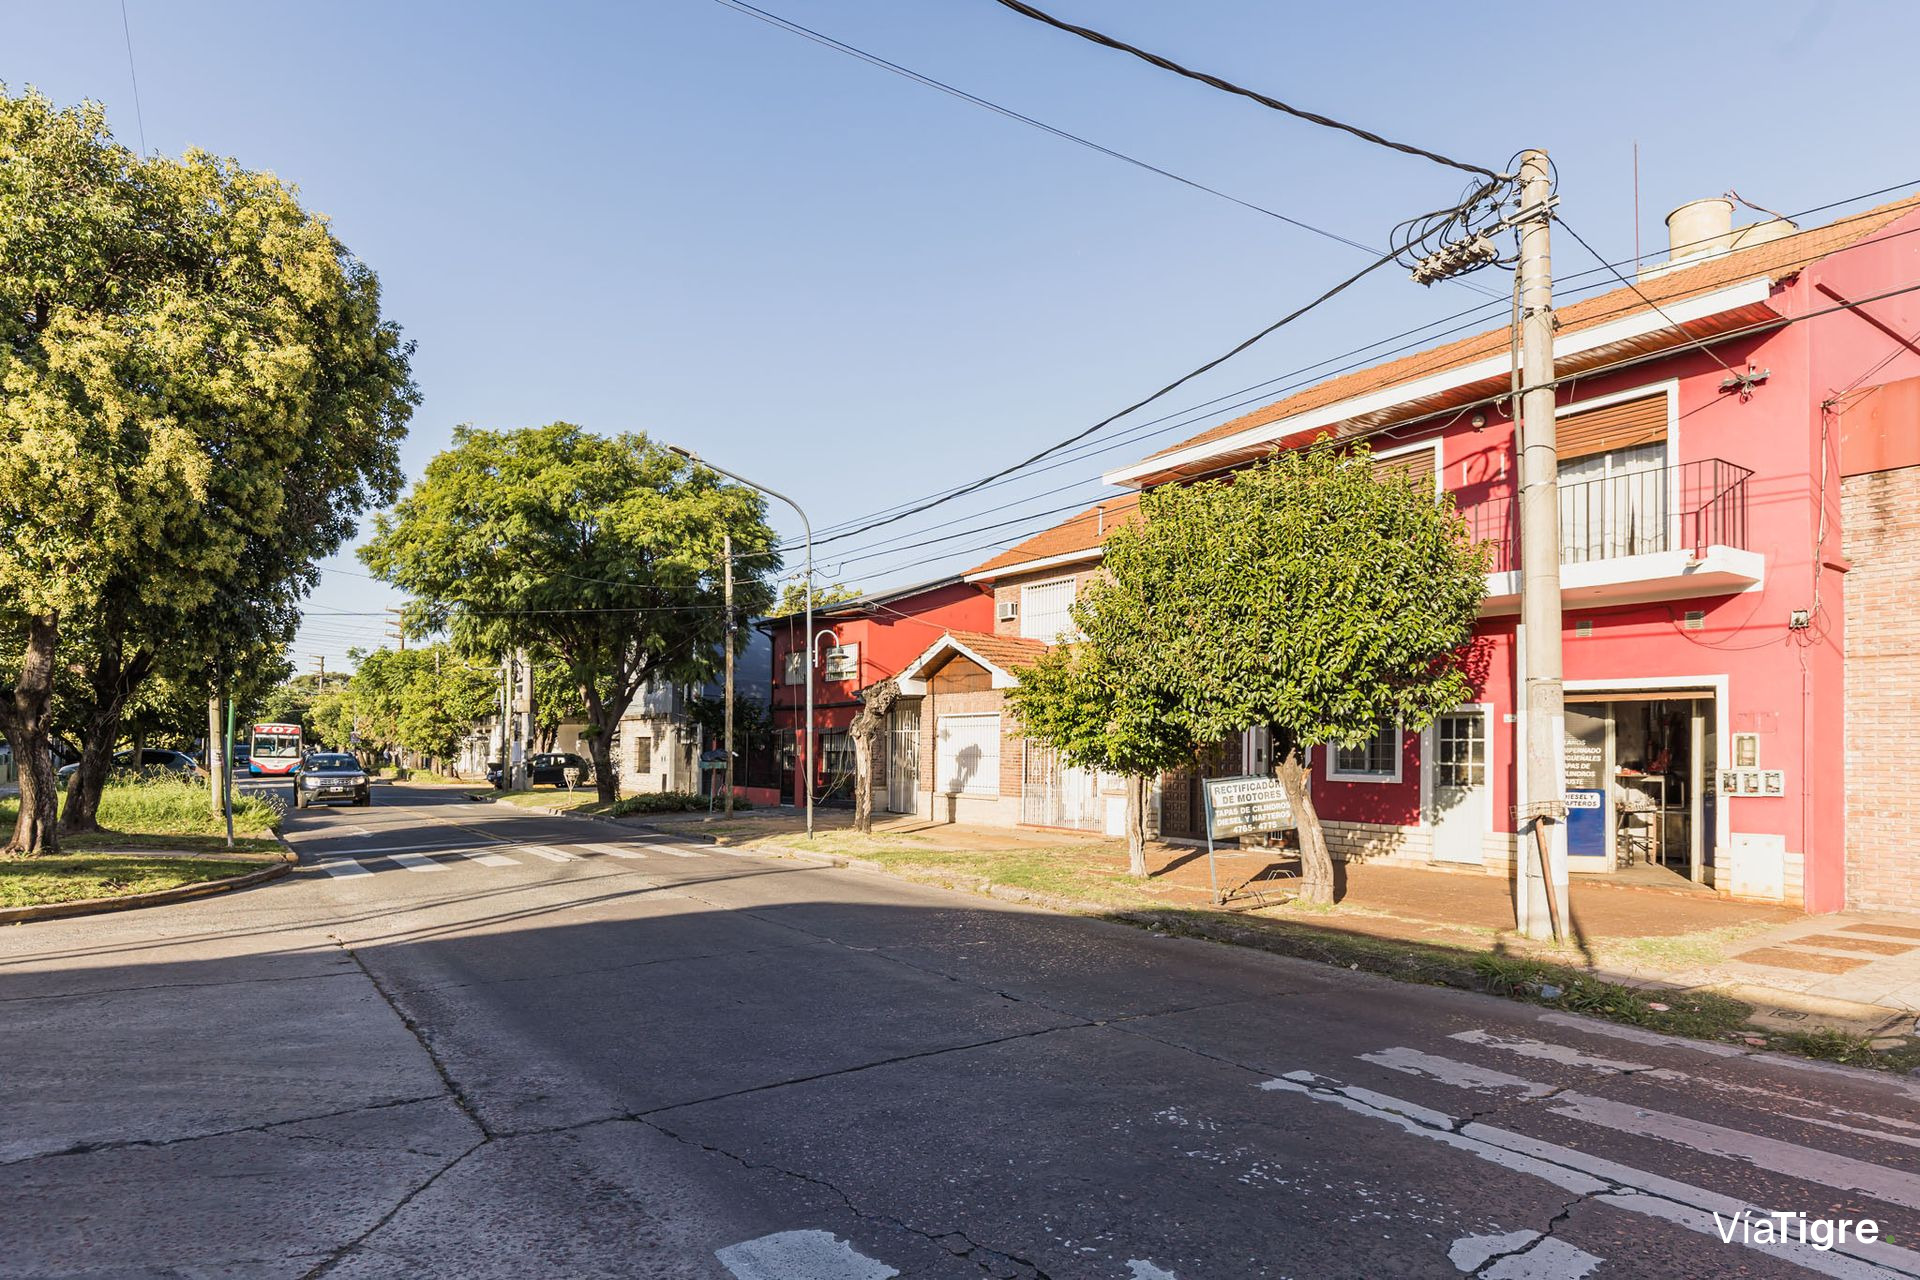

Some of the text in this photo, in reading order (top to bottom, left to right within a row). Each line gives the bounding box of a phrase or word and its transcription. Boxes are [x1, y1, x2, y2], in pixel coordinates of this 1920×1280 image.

[259, 726, 297, 734] 707
[1214, 780, 1284, 795] RECTIFICADOR
[1222, 790, 1281, 804] DE MOTORES
[1215, 807, 1239, 817] TAPAS
[1240, 806, 1251, 814] DE
[1217, 816, 1243, 826] DIESEL
